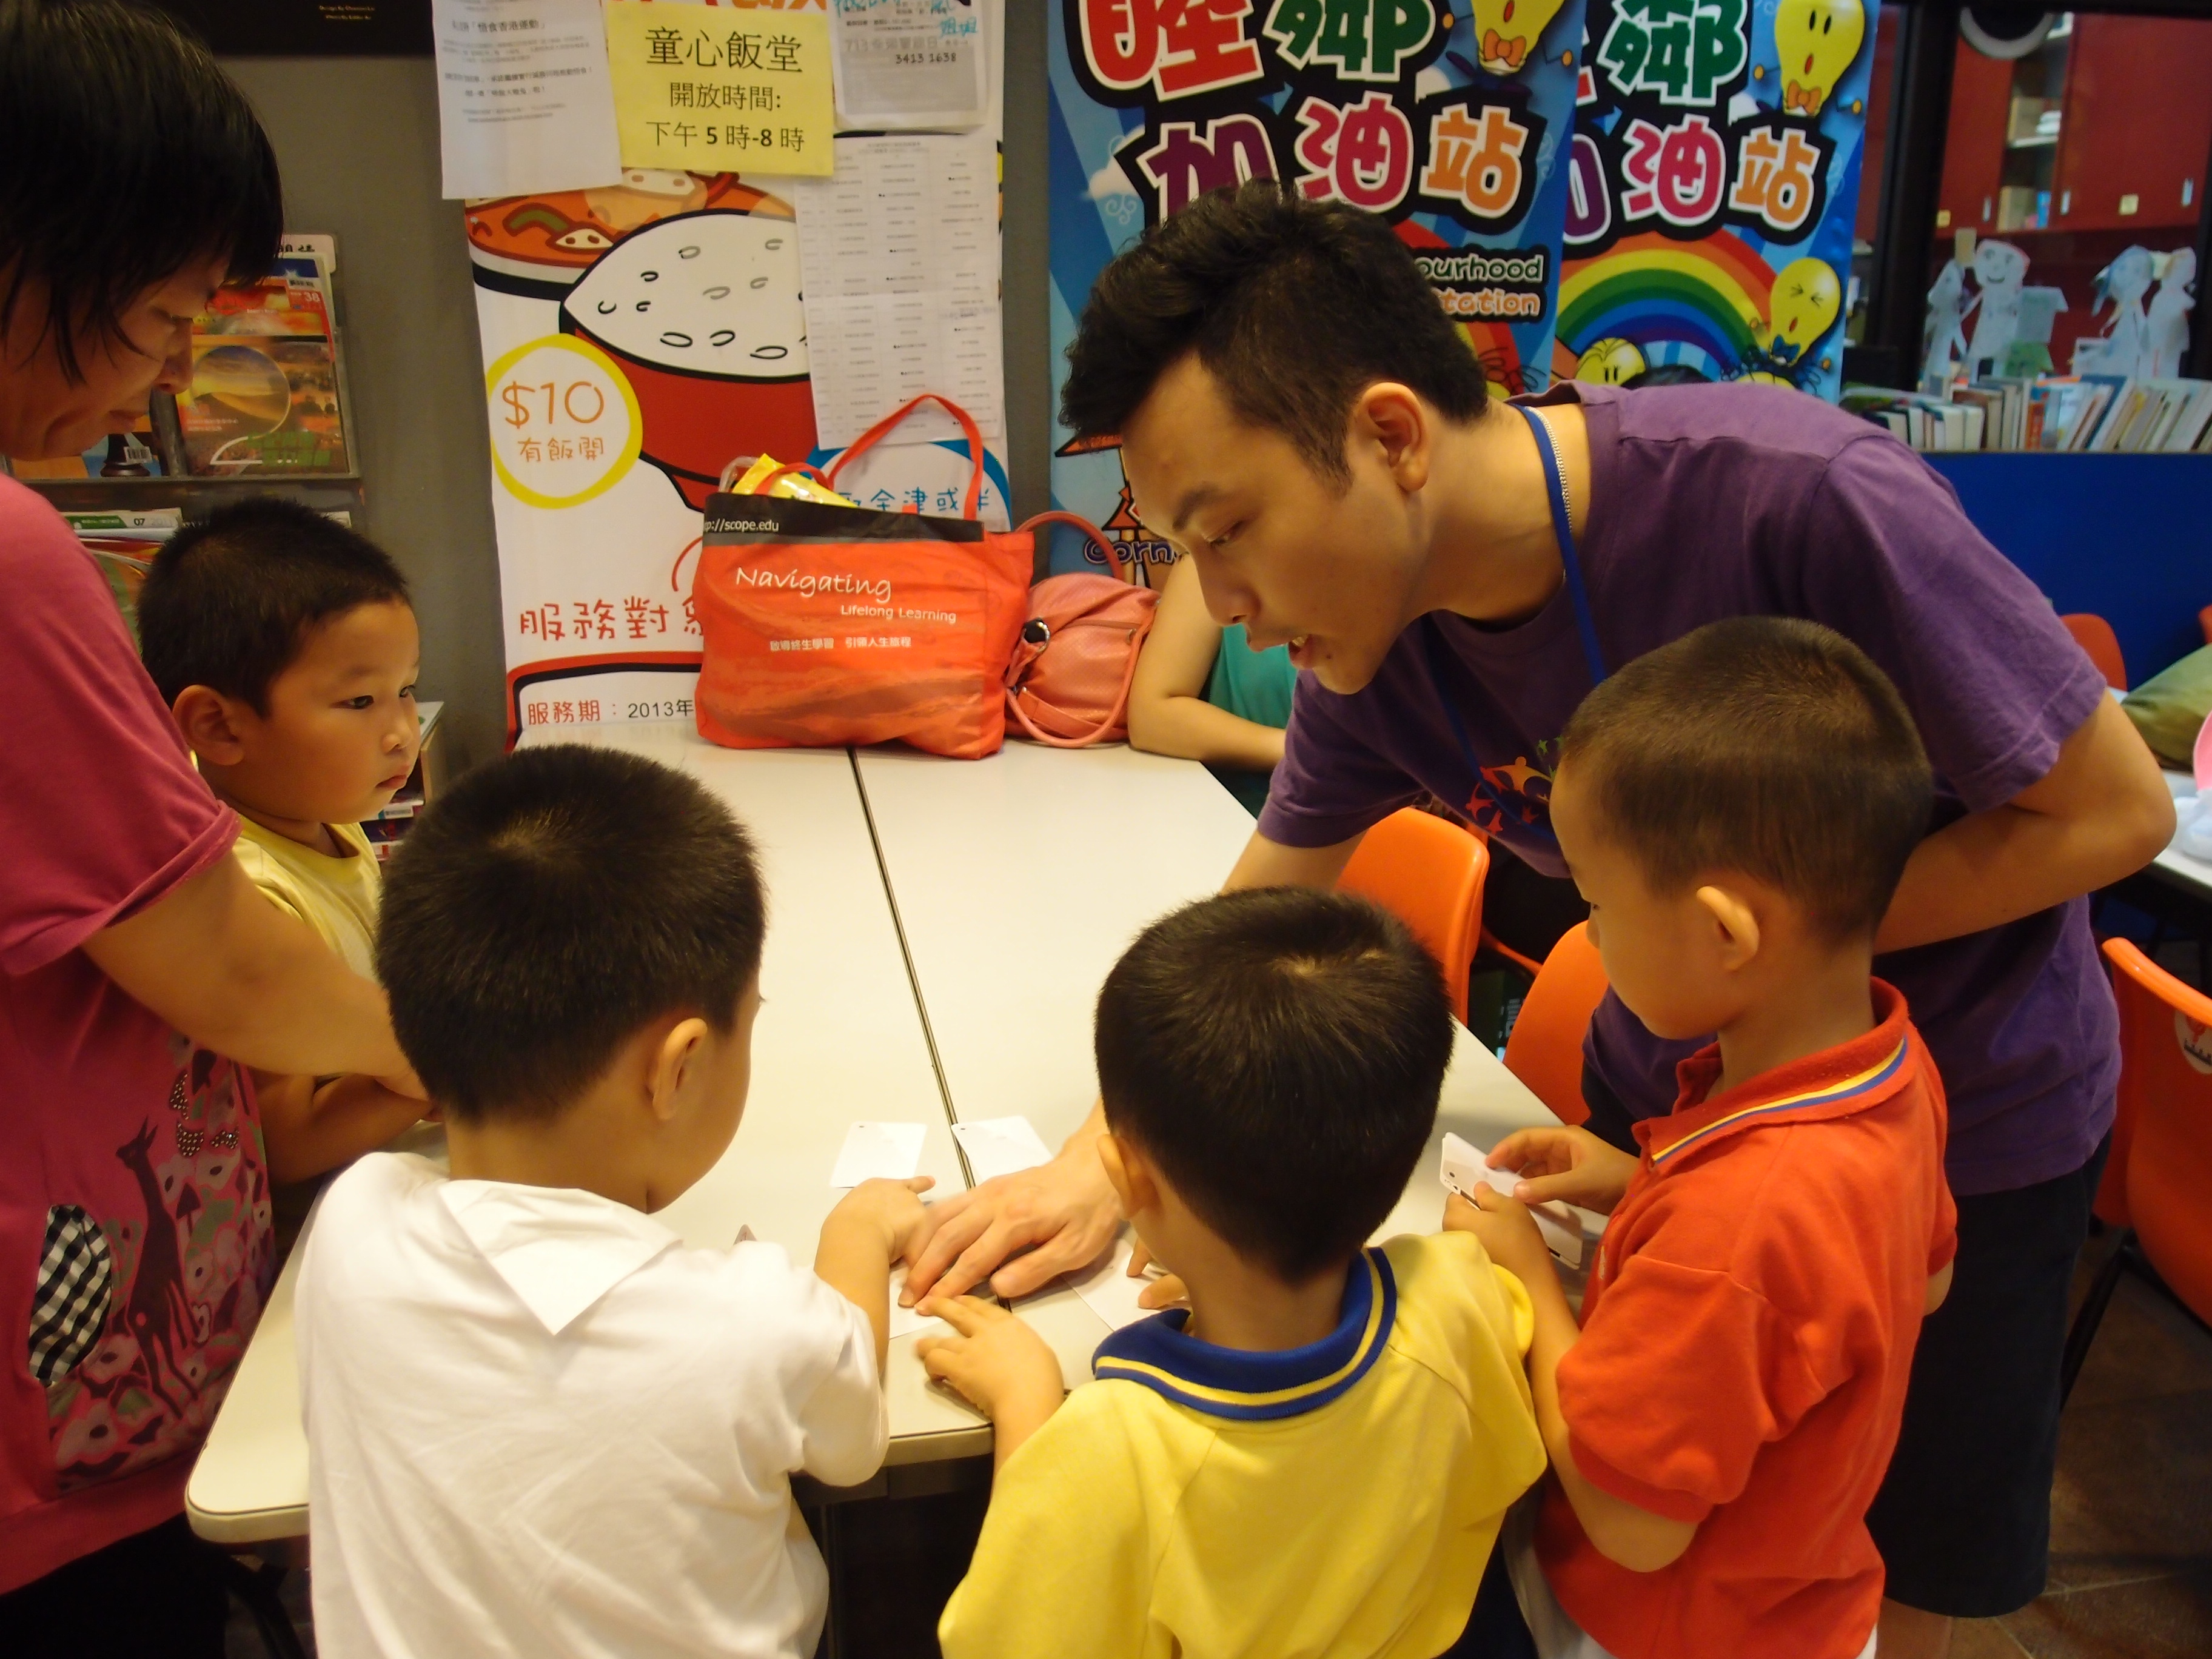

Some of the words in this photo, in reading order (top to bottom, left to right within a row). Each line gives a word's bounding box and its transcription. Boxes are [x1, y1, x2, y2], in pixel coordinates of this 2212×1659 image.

[645, 26, 803, 72] 童心飯堂
[896, 53, 924, 64] 3413
[929, 52, 957, 63] 1638
[1577, 0, 1748, 107] 鄰
[669, 82, 781, 112] 開放時間:
[646, 121, 698, 147] 下午
[706, 126, 718, 145] 5
[1136, 90, 1529, 220] 加油站
[1430, 286, 1541, 317] tation
[501, 381, 605, 429] $10
[518, 437, 605, 462] 有飯開
[1083, 540, 1178, 565] Corn
[736, 566, 891, 604] Navigating
[841, 605, 894, 619] Lifelong
[899, 607, 957, 624] Learning
[845, 636, 911, 648] 引領人生旅程
